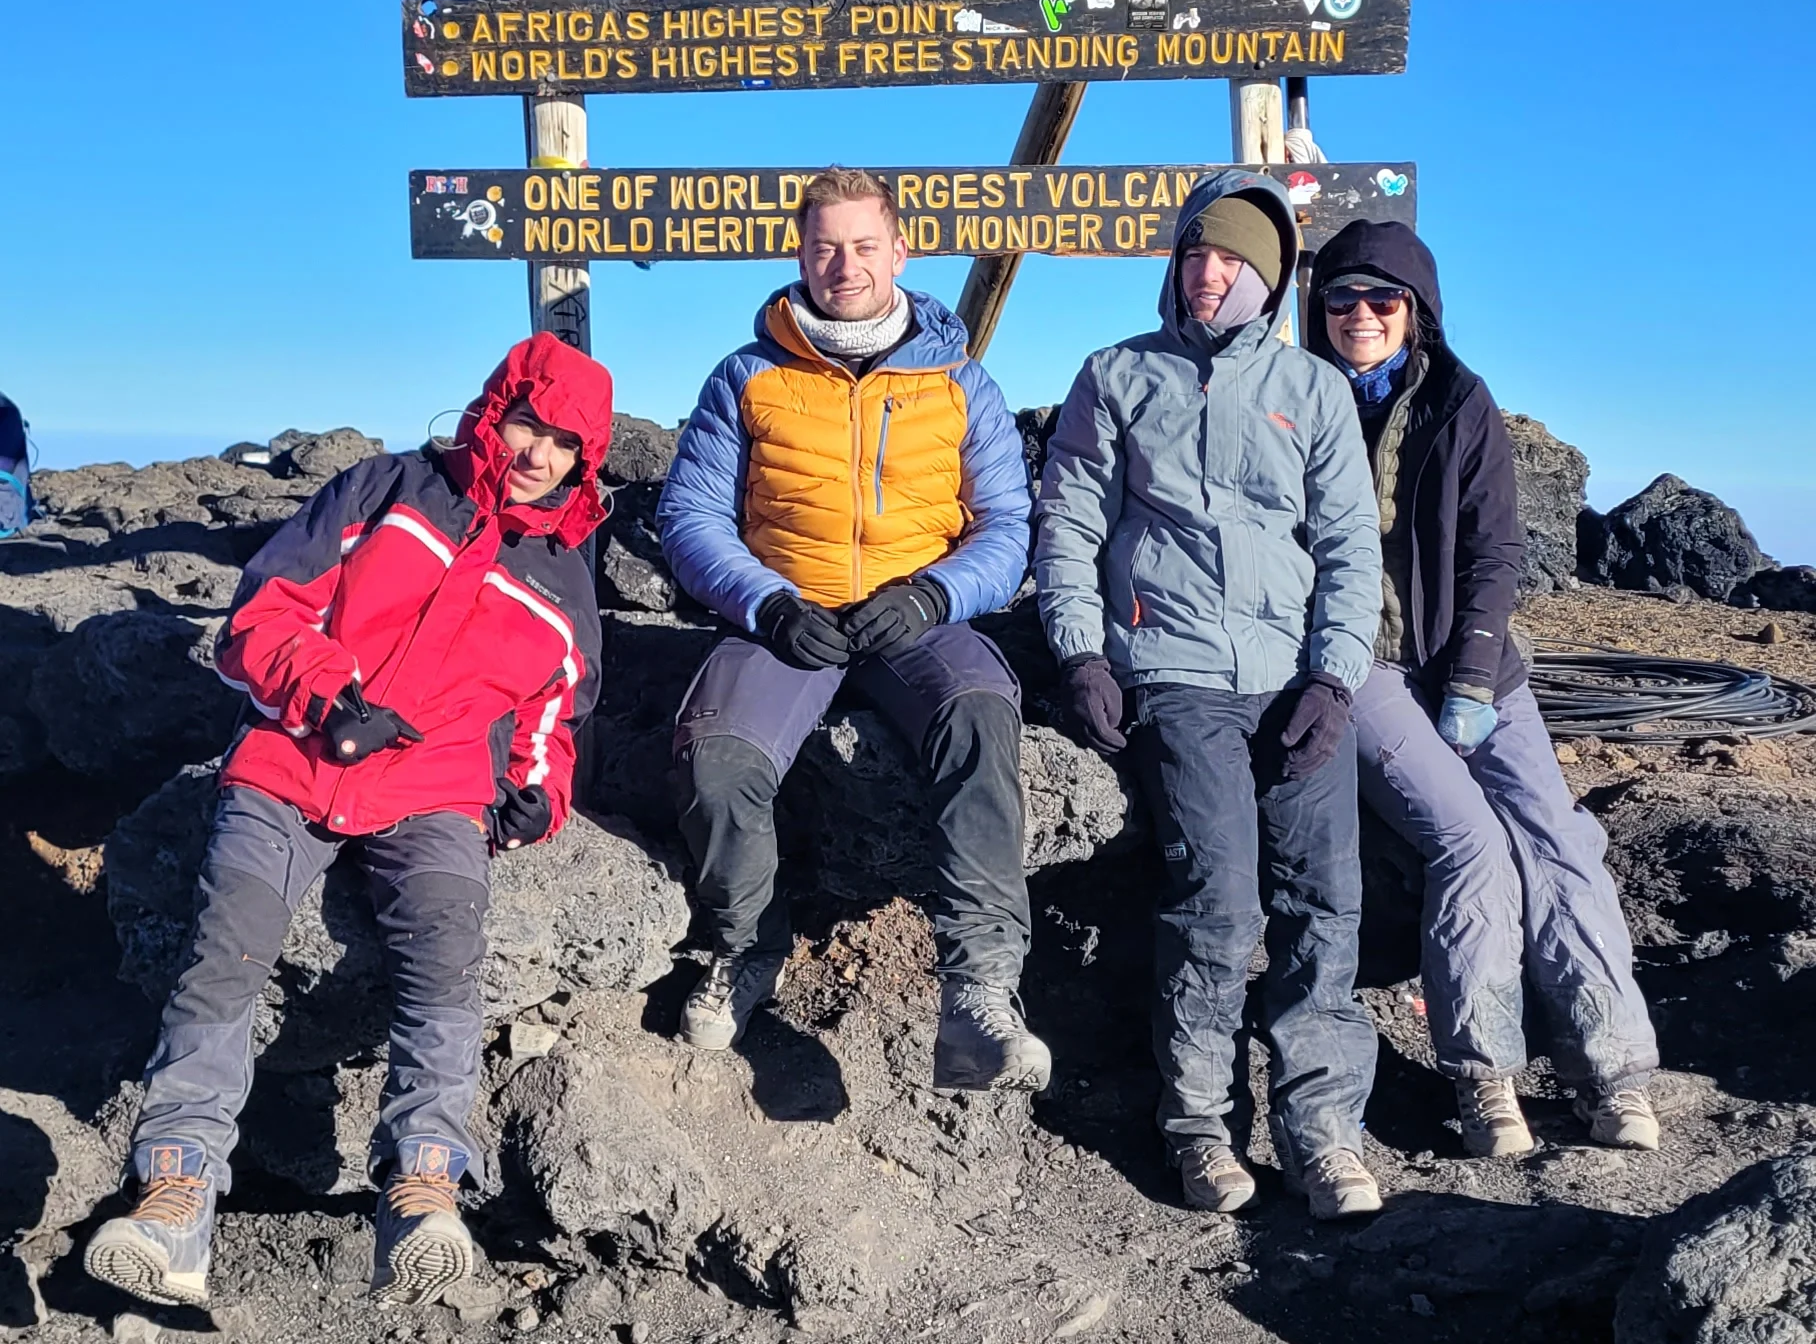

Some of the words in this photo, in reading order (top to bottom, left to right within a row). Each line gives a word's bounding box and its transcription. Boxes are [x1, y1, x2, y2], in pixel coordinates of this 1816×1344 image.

[471, 11, 650, 43] AFRICAS
[664, 6, 829, 40] HIGHEST
[851, 2, 963, 34] POINT
[471, 47, 638, 81] WORLD'S
[652, 43, 825, 77] HIGHEST
[838, 39, 939, 73] FREE
[952, 35, 1139, 71] STANDING
[1157, 30, 1345, 65] MOUNTAIN
[524, 175, 601, 211] ONE
[612, 175, 658, 210] OF
[670, 175, 817, 211] WORLD'
[880, 174, 1031, 210] RGEST
[1043, 172, 1198, 208] VOLCAN
[524, 216, 654, 253] WORLD
[666, 216, 802, 253] HERITA
[899, 216, 941, 250] ND
[956, 214, 1104, 251] WONDER
[1115, 214, 1161, 250] OF
